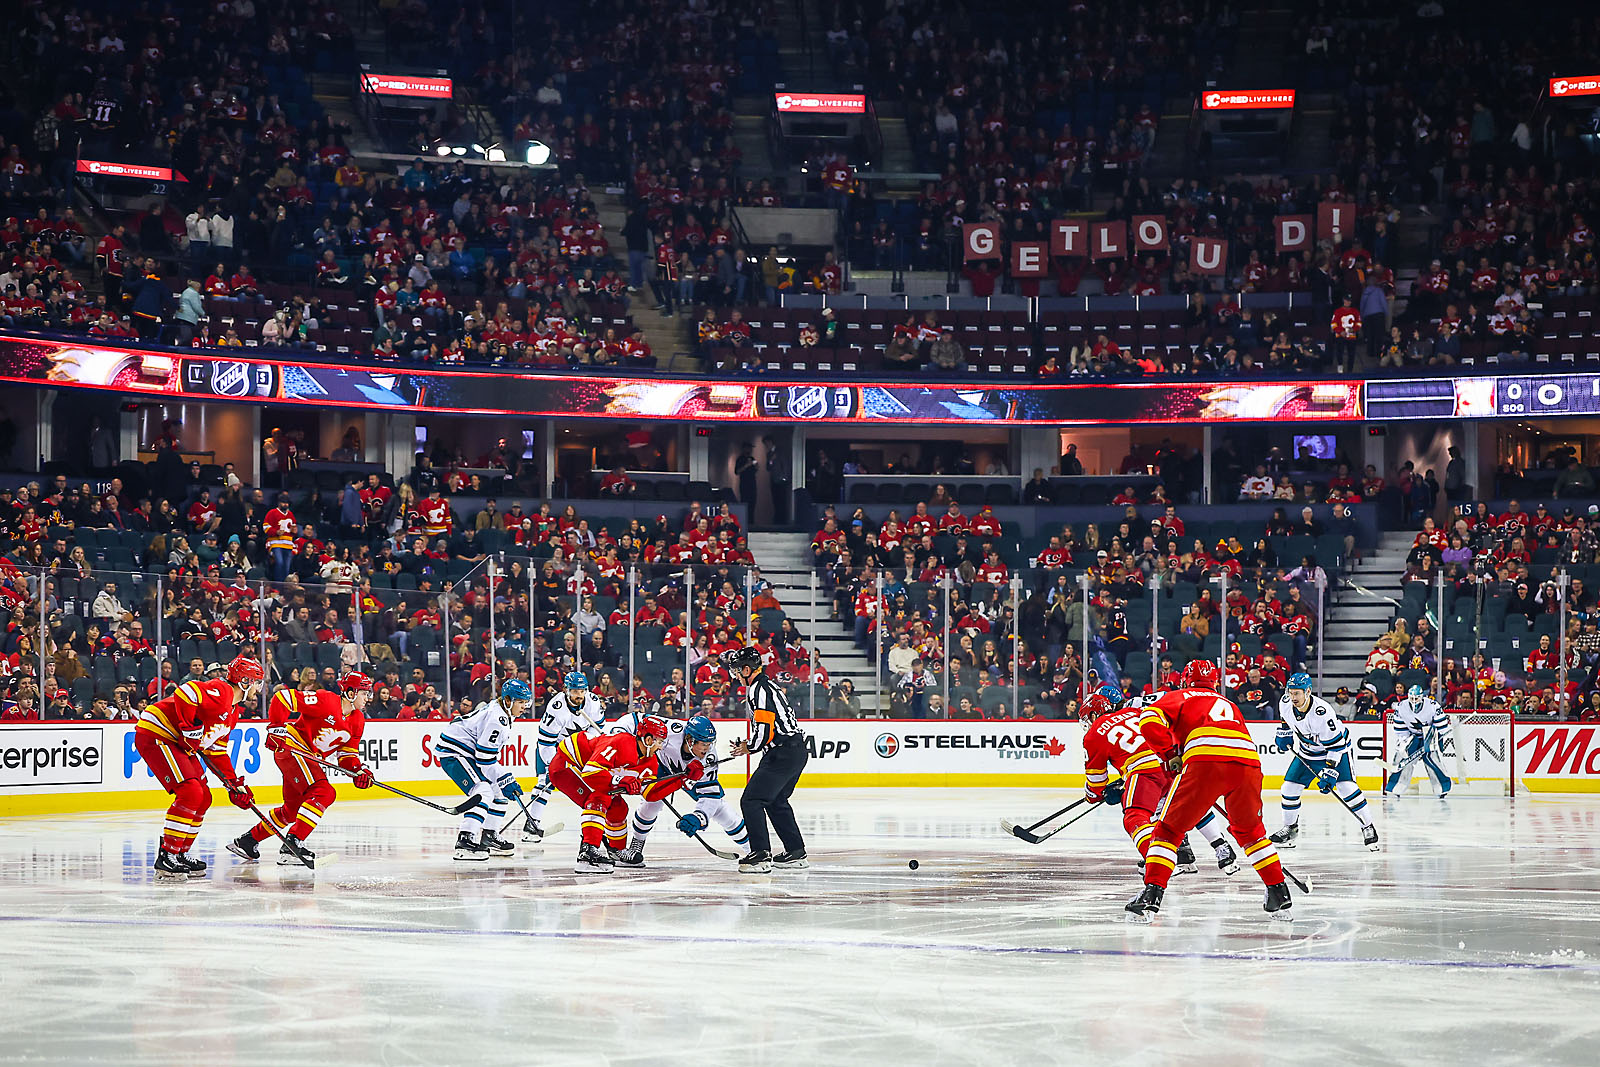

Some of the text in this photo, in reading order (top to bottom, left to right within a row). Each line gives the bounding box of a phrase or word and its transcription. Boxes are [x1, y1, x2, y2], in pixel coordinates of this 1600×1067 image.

[389, 81, 407, 89] RED
[1578, 81, 1597, 90] RED
[801, 99, 819, 107] RED
[95, 106, 111, 121] 11
[108, 166, 123, 174] RED
[219, 368, 242, 390] NHL
[1507, 383, 1522, 400] 0
[1537, 383, 1563, 406] 0
[796, 391, 821, 413] NHL
[1208, 698, 1240, 724] 4
[1327, 719, 1337, 731] 9
[489, 730, 500, 743] 2
[904, 735, 1047, 748] STEELHAUS
[0, 739, 99, 777] erprise
[228, 728, 261, 774] 73
[359, 739, 398, 769] AGLE
[600, 745, 618, 761] 11
[997, 748, 1050, 760] Tryton
